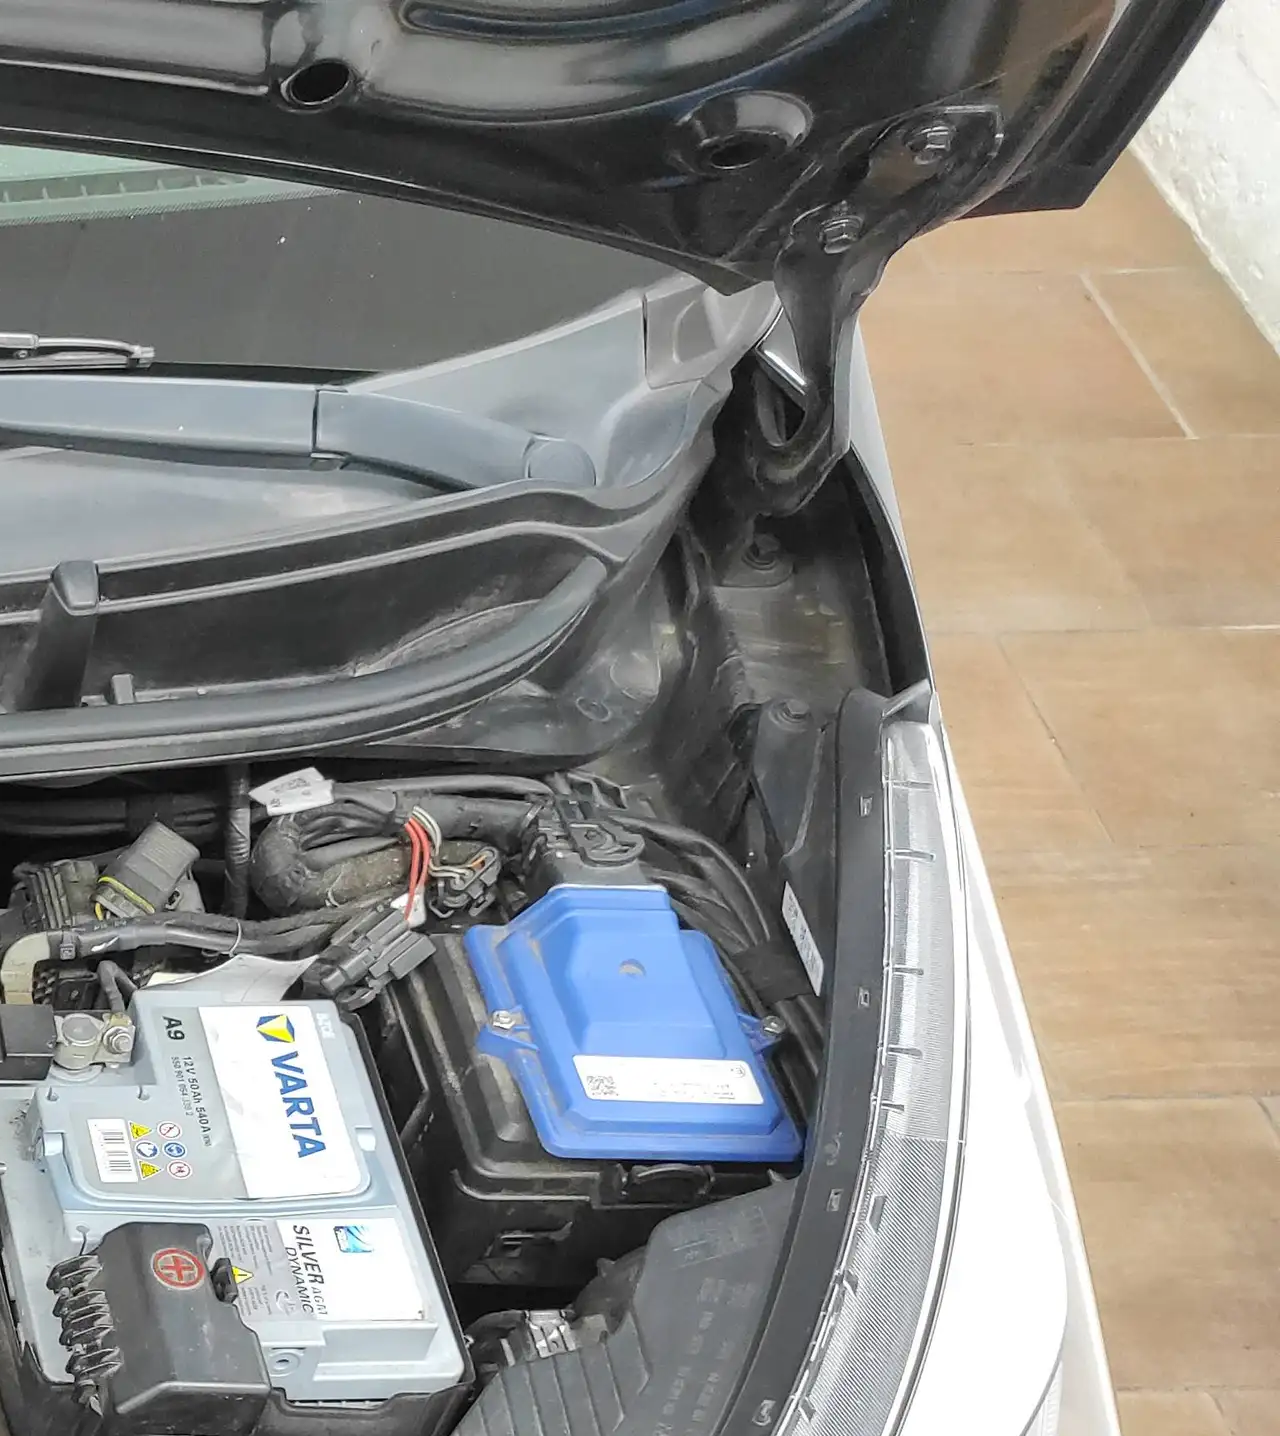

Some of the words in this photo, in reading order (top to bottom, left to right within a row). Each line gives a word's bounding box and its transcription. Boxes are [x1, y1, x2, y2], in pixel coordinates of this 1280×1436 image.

[162, 1015, 185, 1041] A9
[182, 1056, 196, 1074] 12V
[188, 1076, 201, 1105] 50Ah
[271, 1051, 327, 1158] VARTA
[285, 1247, 314, 1314] DYNAMIC
[293, 1225, 325, 1284] SILVER
[311, 1287, 328, 1315] AGM
